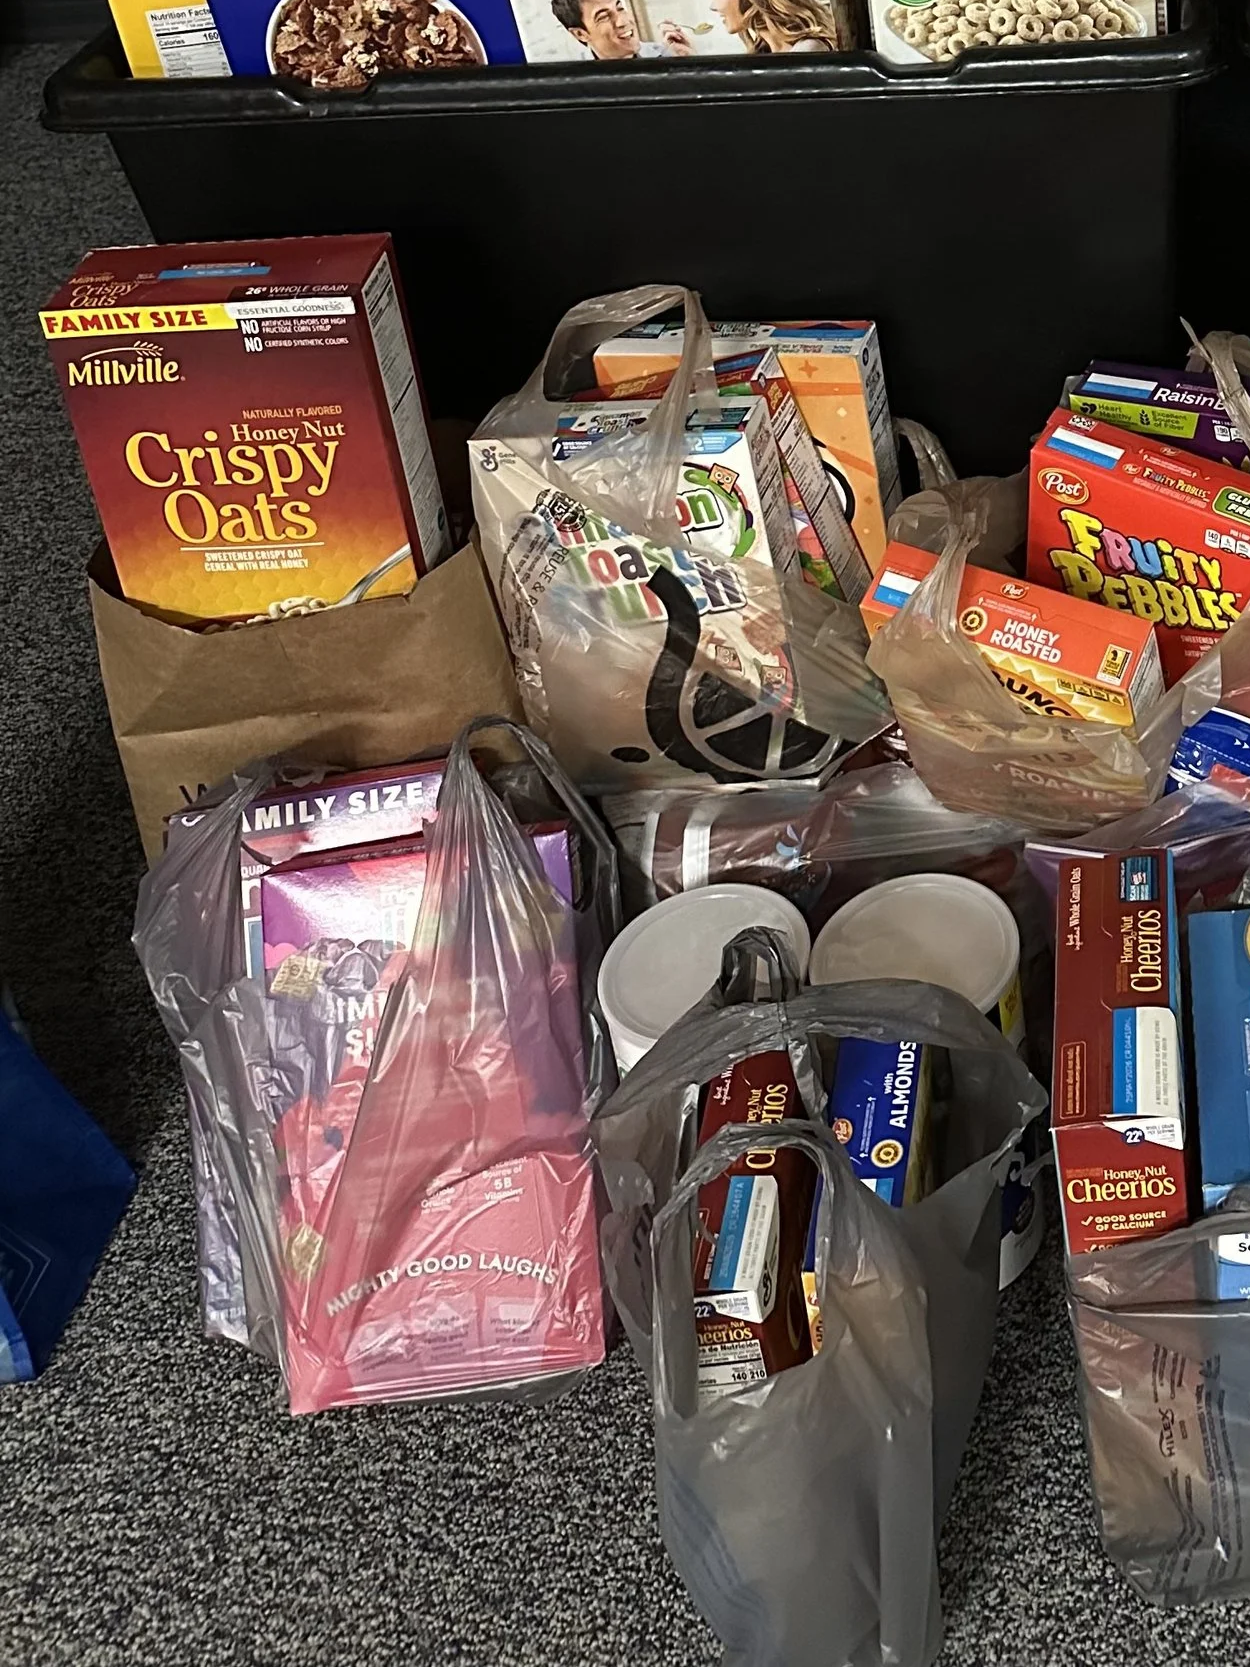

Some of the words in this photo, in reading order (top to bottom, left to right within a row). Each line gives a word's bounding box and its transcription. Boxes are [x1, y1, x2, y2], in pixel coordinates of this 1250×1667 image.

[46, 312, 140, 334] FAMILY
[153, 310, 208, 327] SIZE
[68, 356, 180, 387] Millville
[230, 422, 298, 445] Honey
[305, 421, 345, 438] Nut
[126, 430, 339, 499] Crispy
[1043, 474, 1084, 500] Post
[164, 488, 318, 543] Oats
[1050, 549, 1243, 632] PEBBLES
[1004, 618, 1061, 646] HONEY
[991, 629, 1062, 665] ROASTED
[889, 1040, 918, 1129] ALMONDS
[1104, 1168, 1139, 1184] Honey
[1143, 1165, 1168, 1177] Nut
[1067, 1176, 1176, 1204] Cheerios
[1095, 1215, 1125, 1225] GOOD
[1126, 1211, 1167, 1222] SOURCE
[1096, 1221, 1108, 1231] OF
[1111, 1219, 1155, 1230] CALCIUM
[324, 1271, 402, 1319] MIGHTY
[405, 1252, 473, 1279] GOOD
[478, 1252, 560, 1286] LAUGHS
